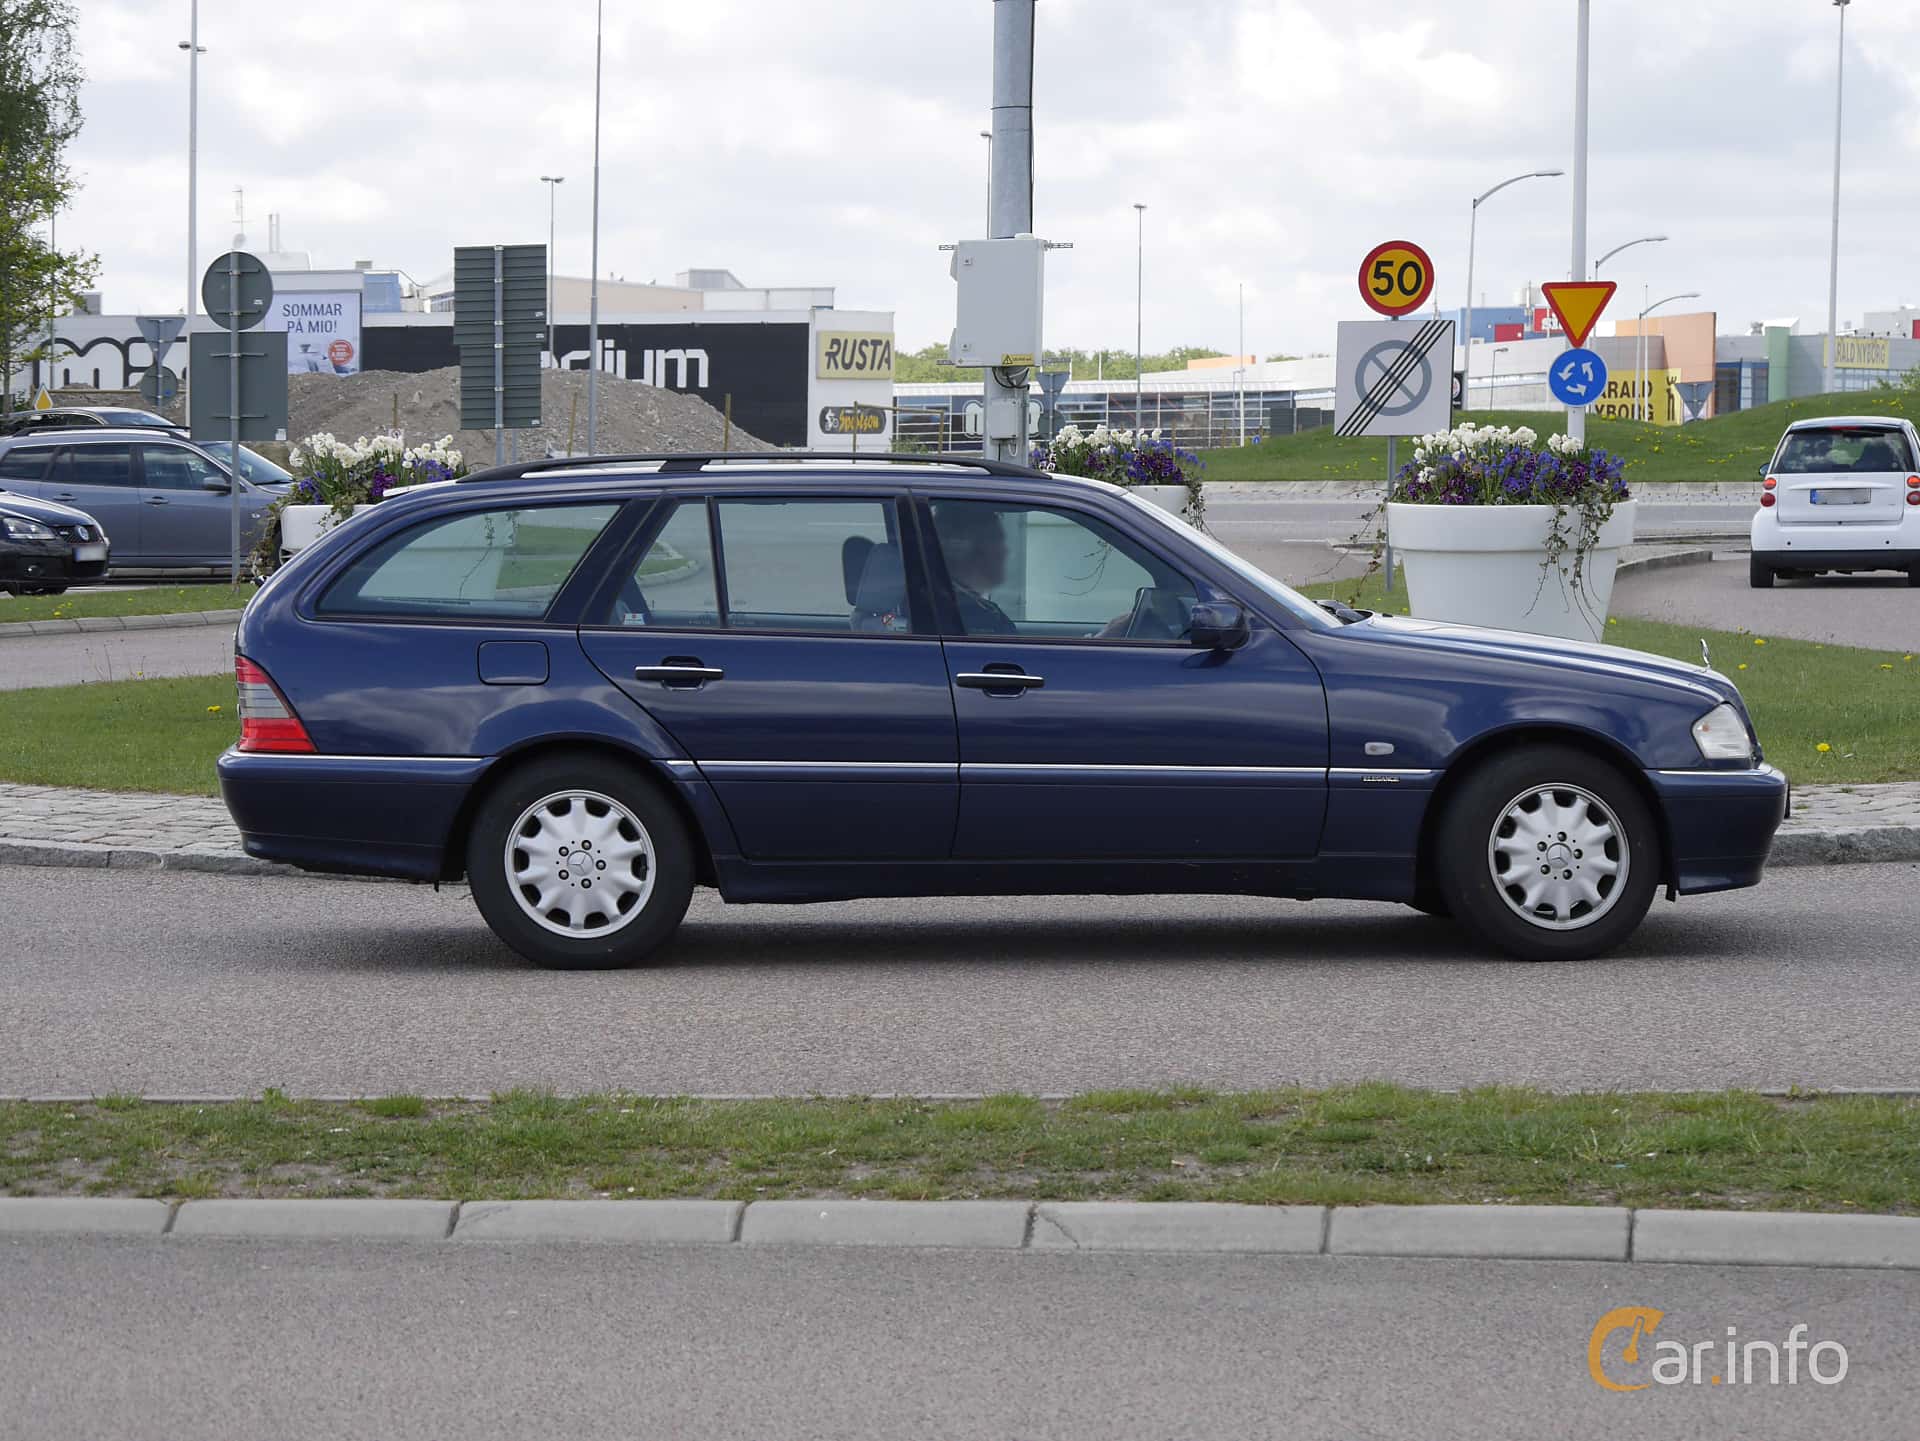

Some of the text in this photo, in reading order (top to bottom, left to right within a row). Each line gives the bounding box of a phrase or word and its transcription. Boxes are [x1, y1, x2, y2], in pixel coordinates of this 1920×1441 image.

[1373, 260, 1423, 297] 50
[282, 303, 343, 318] SOMMAR
[287, 317, 337, 333] PÅ MIO!
[825, 338, 891, 371] RUSTA
